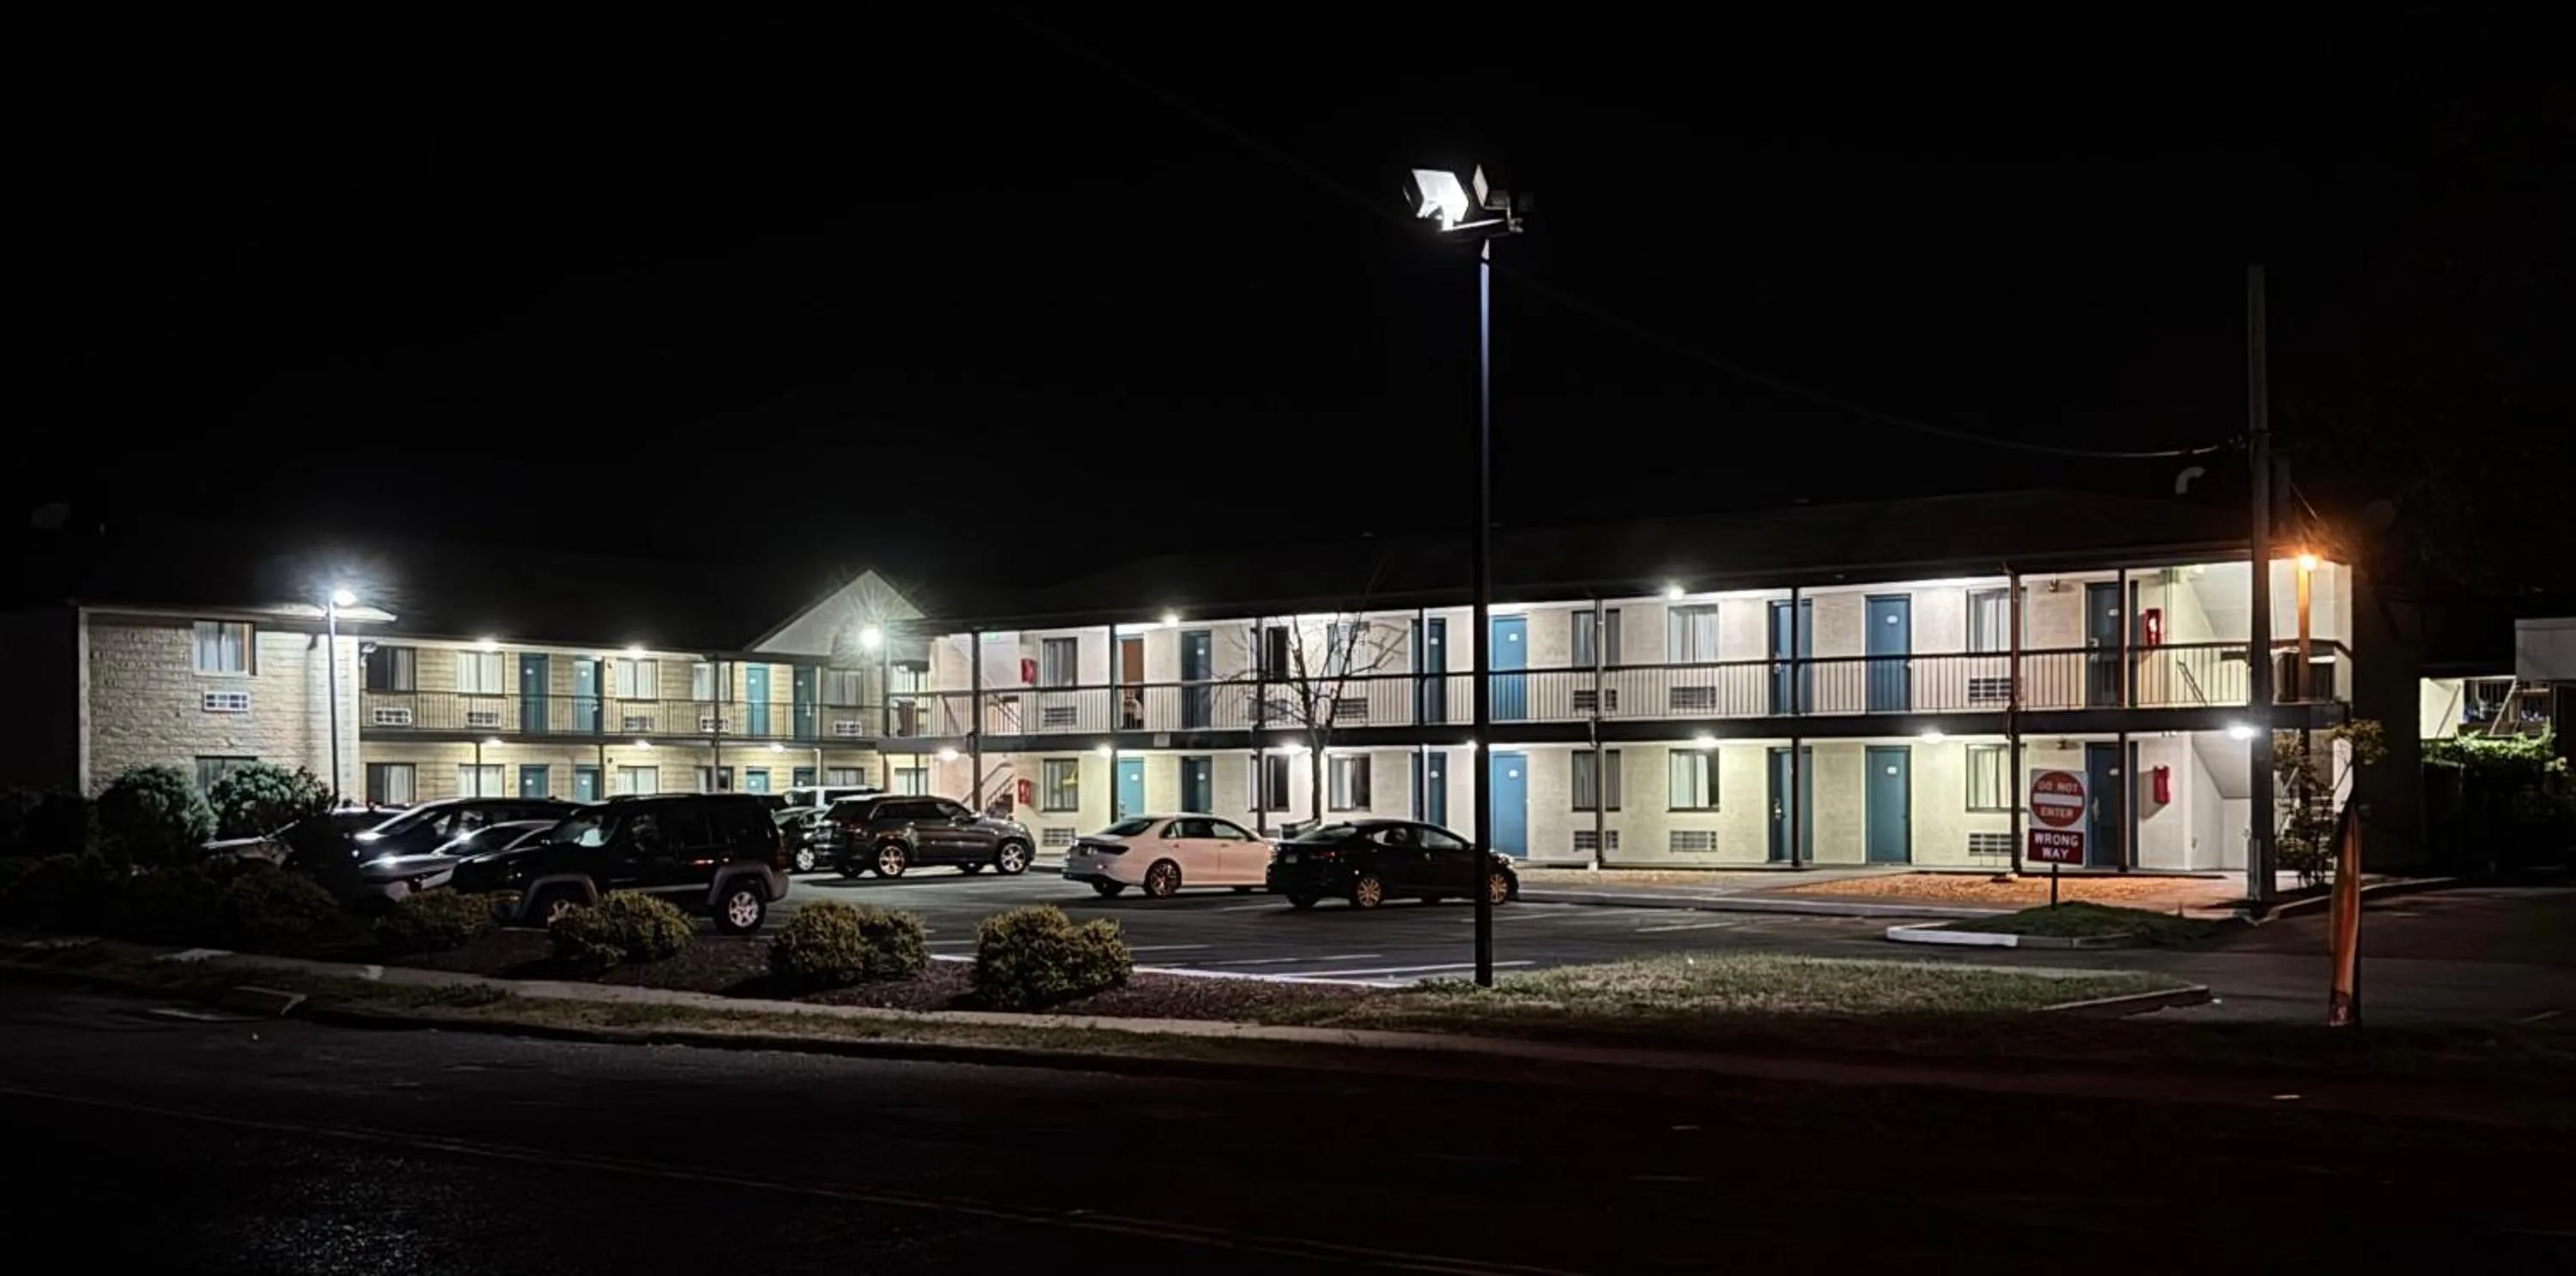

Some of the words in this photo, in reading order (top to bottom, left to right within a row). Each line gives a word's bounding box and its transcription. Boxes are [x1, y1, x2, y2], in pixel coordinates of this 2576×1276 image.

[2038, 781, 2053, 791] DO
[2057, 782, 2078, 793] NOT
[2039, 807, 2074, 818] ENTER
[2034, 832, 2079, 848] WRONG
[2042, 847, 2069, 859] WAY
